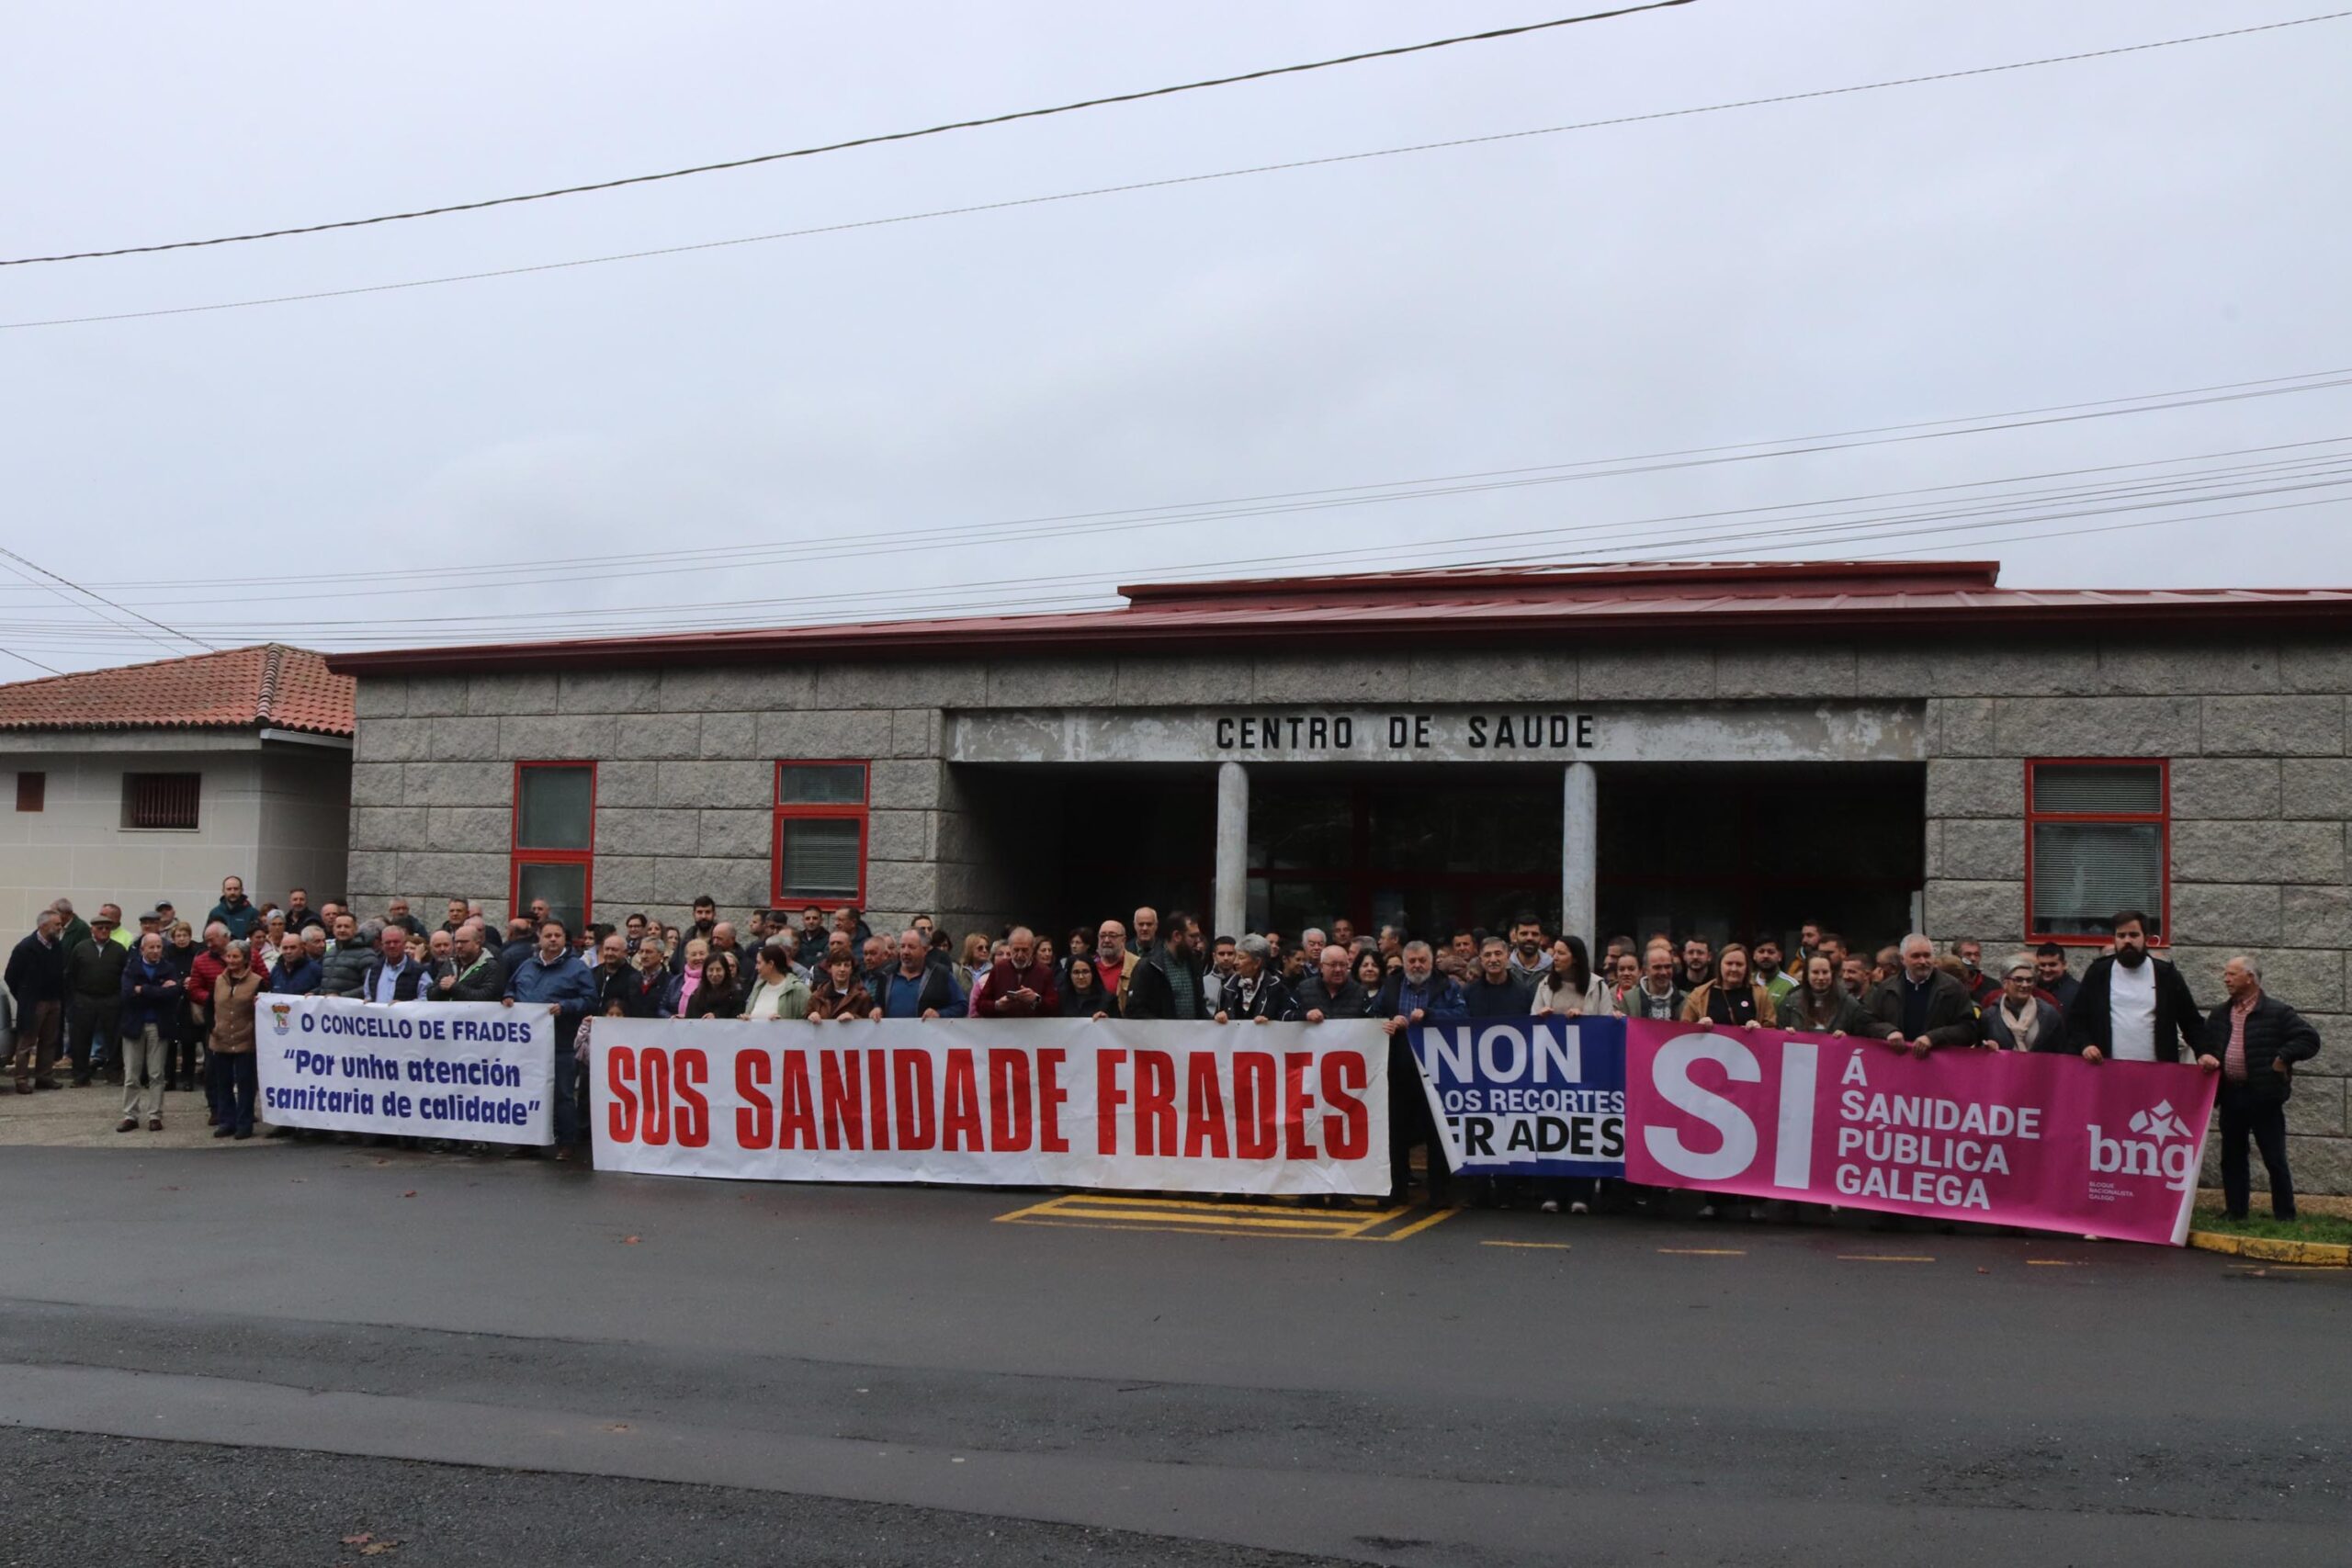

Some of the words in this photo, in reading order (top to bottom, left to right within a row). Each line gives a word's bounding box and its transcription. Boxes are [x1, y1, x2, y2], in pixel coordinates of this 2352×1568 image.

[1216, 716, 1352, 750] CENTRO
[1388, 716, 1431, 749] DE
[1468, 715, 1594, 749] SAUDE
[300, 1013, 314, 1032] O
[321, 1015, 413, 1039] CONCELLO
[419, 1020, 446, 1040] DE
[452, 1021, 532, 1043] FRADES
[343, 1054, 399, 1080] unha
[407, 1057, 521, 1087] atención
[1423, 1024, 1581, 1084] NON
[1841, 1048, 1868, 1087] Á
[266, 1085, 374, 1114] sanitaria
[382, 1090, 412, 1118] de
[607, 1045, 709, 1148] SOS
[734, 1047, 1069, 1153] SANIDADE
[1096, 1049, 1369, 1160] FRADES
[1441, 1089, 1482, 1111] OS
[1489, 1089, 1625, 1113] RECORTES
[1644, 1032, 1818, 1190] SI
[1839, 1089, 2041, 1140] SANIDADE
[1838, 1123, 2010, 1176] PÚBLICA
[2086, 1123, 2194, 1191] bng
[1836, 1163, 1991, 1211] GALEGA
